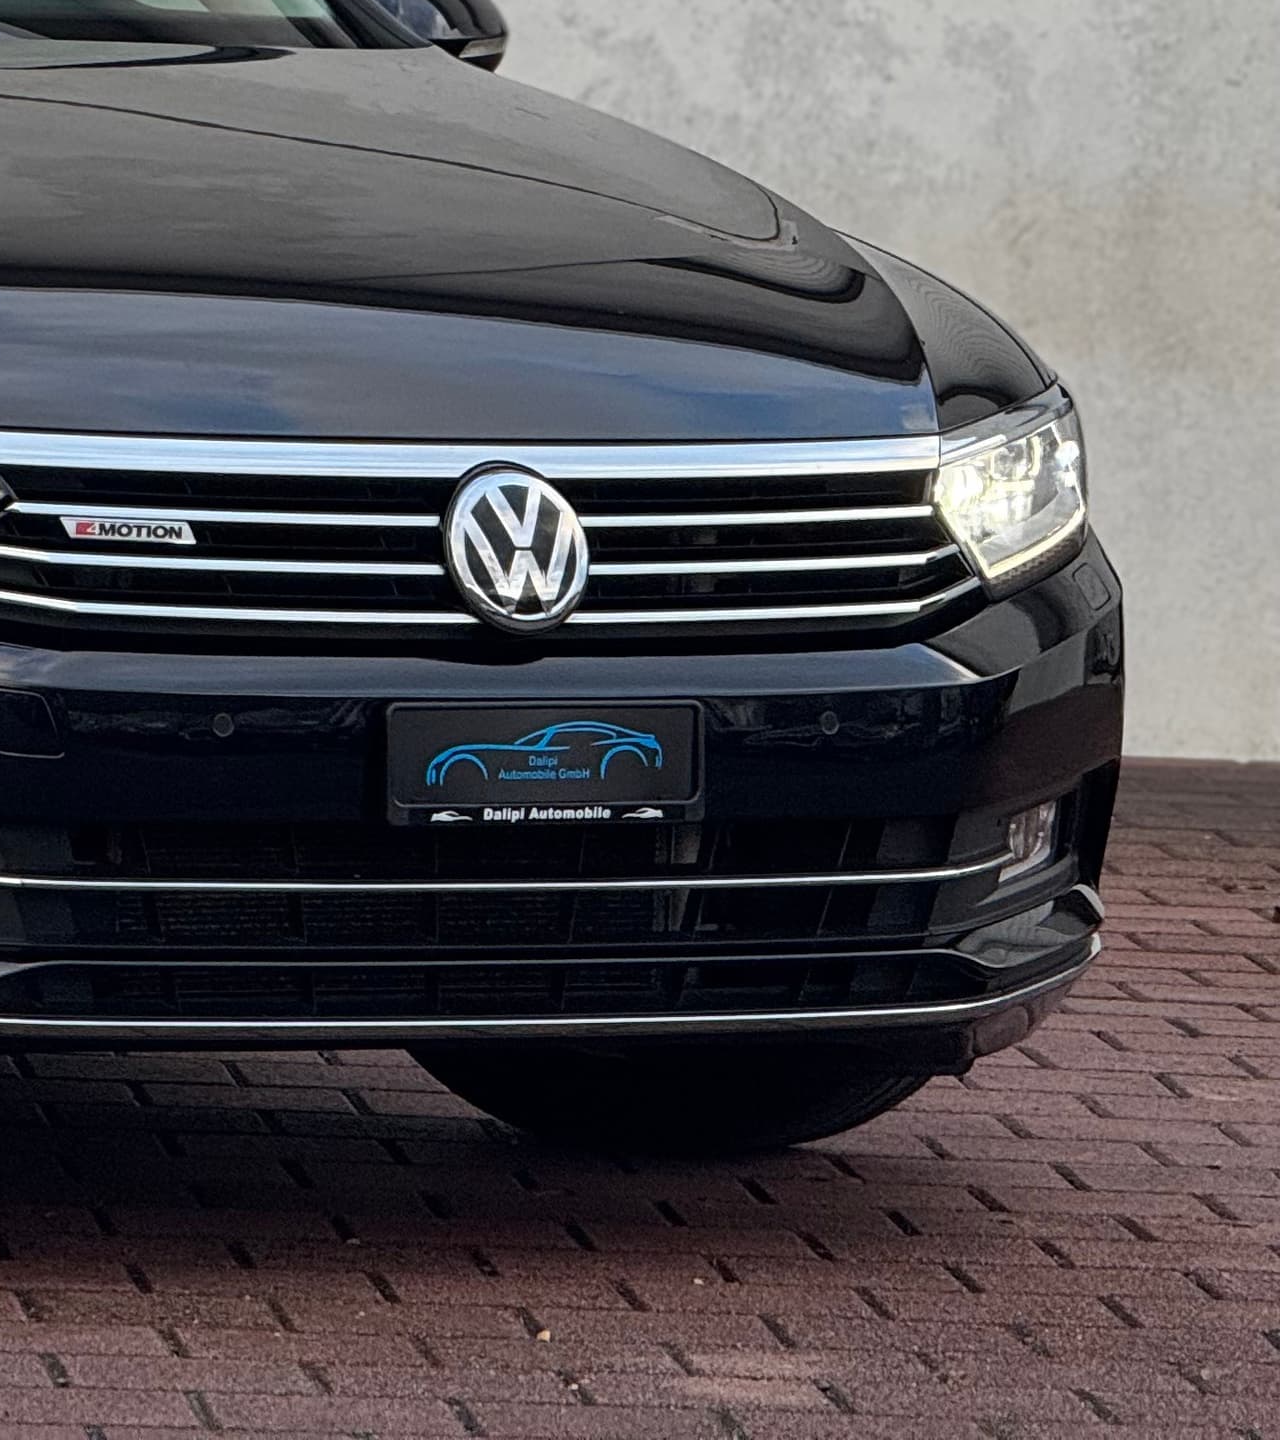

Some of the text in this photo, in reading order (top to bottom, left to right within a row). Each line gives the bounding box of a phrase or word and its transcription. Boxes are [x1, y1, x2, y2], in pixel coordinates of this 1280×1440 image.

[528, 755, 558, 768] Dalipi
[498, 768, 590, 780] Automobile GmbH
[483, 805, 612, 823] Dalipi Automobile
